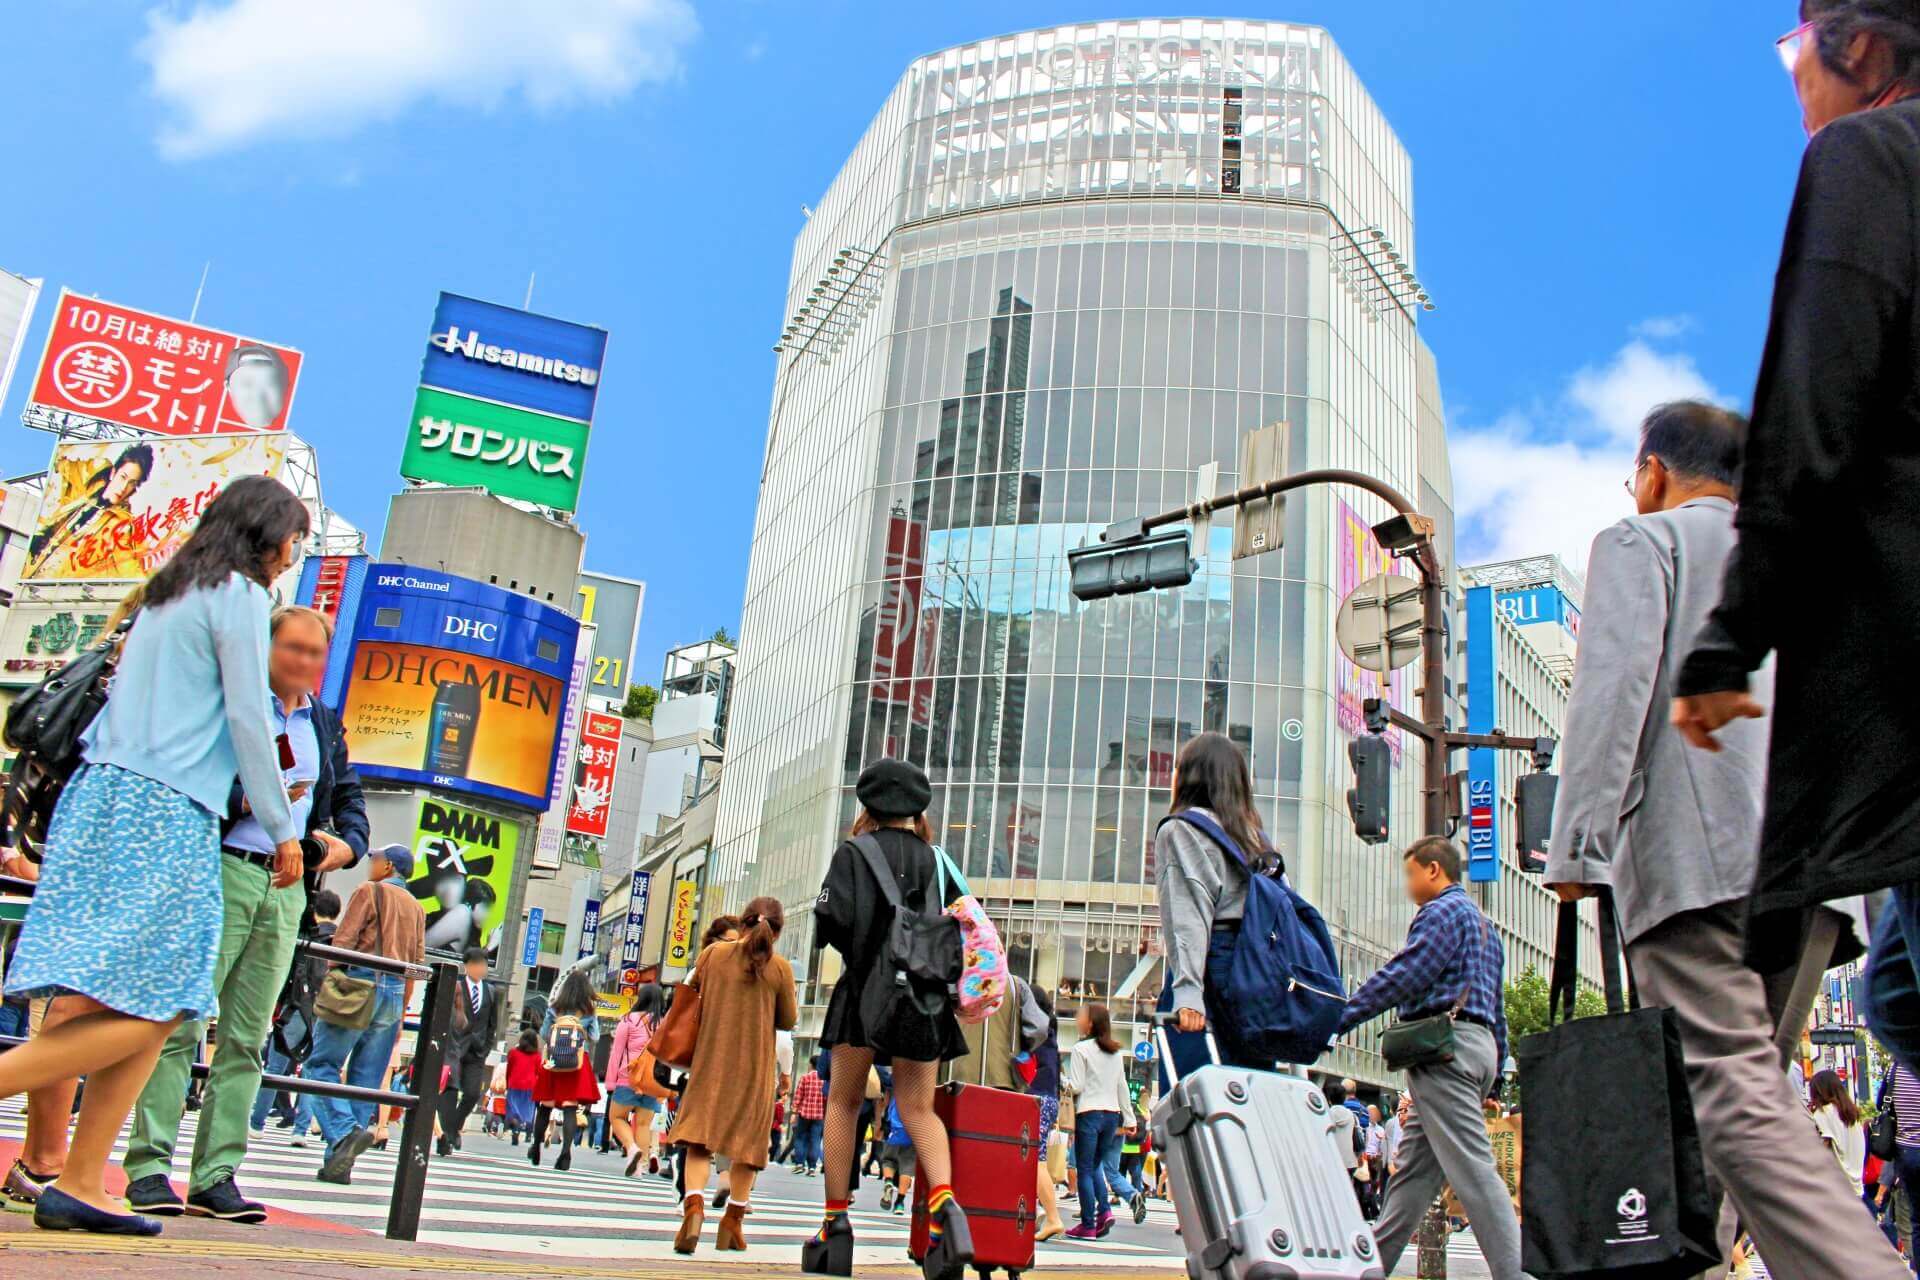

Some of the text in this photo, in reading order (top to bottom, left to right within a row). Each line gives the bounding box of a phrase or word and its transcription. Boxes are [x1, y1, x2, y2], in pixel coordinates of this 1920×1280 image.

[68, 305, 224, 364] 10月は絶対!
[430, 326, 599, 386] Hisamitsu
[66, 349, 121, 399] 禁
[144, 357, 213, 395] モン
[129, 389, 206, 433] スト!
[419, 415, 575, 479] サロンパス
[378, 575, 450, 592] DHC Channel
[444, 615, 498, 642] DHC
[593, 656, 623, 688] 21
[433, 775, 454, 785] DHC
[420, 801, 500, 849] DMM
[1471, 779, 1493, 862] SEIBU
[415, 835, 471, 874] FX
[624, 876, 648, 961] 洋服の青山
